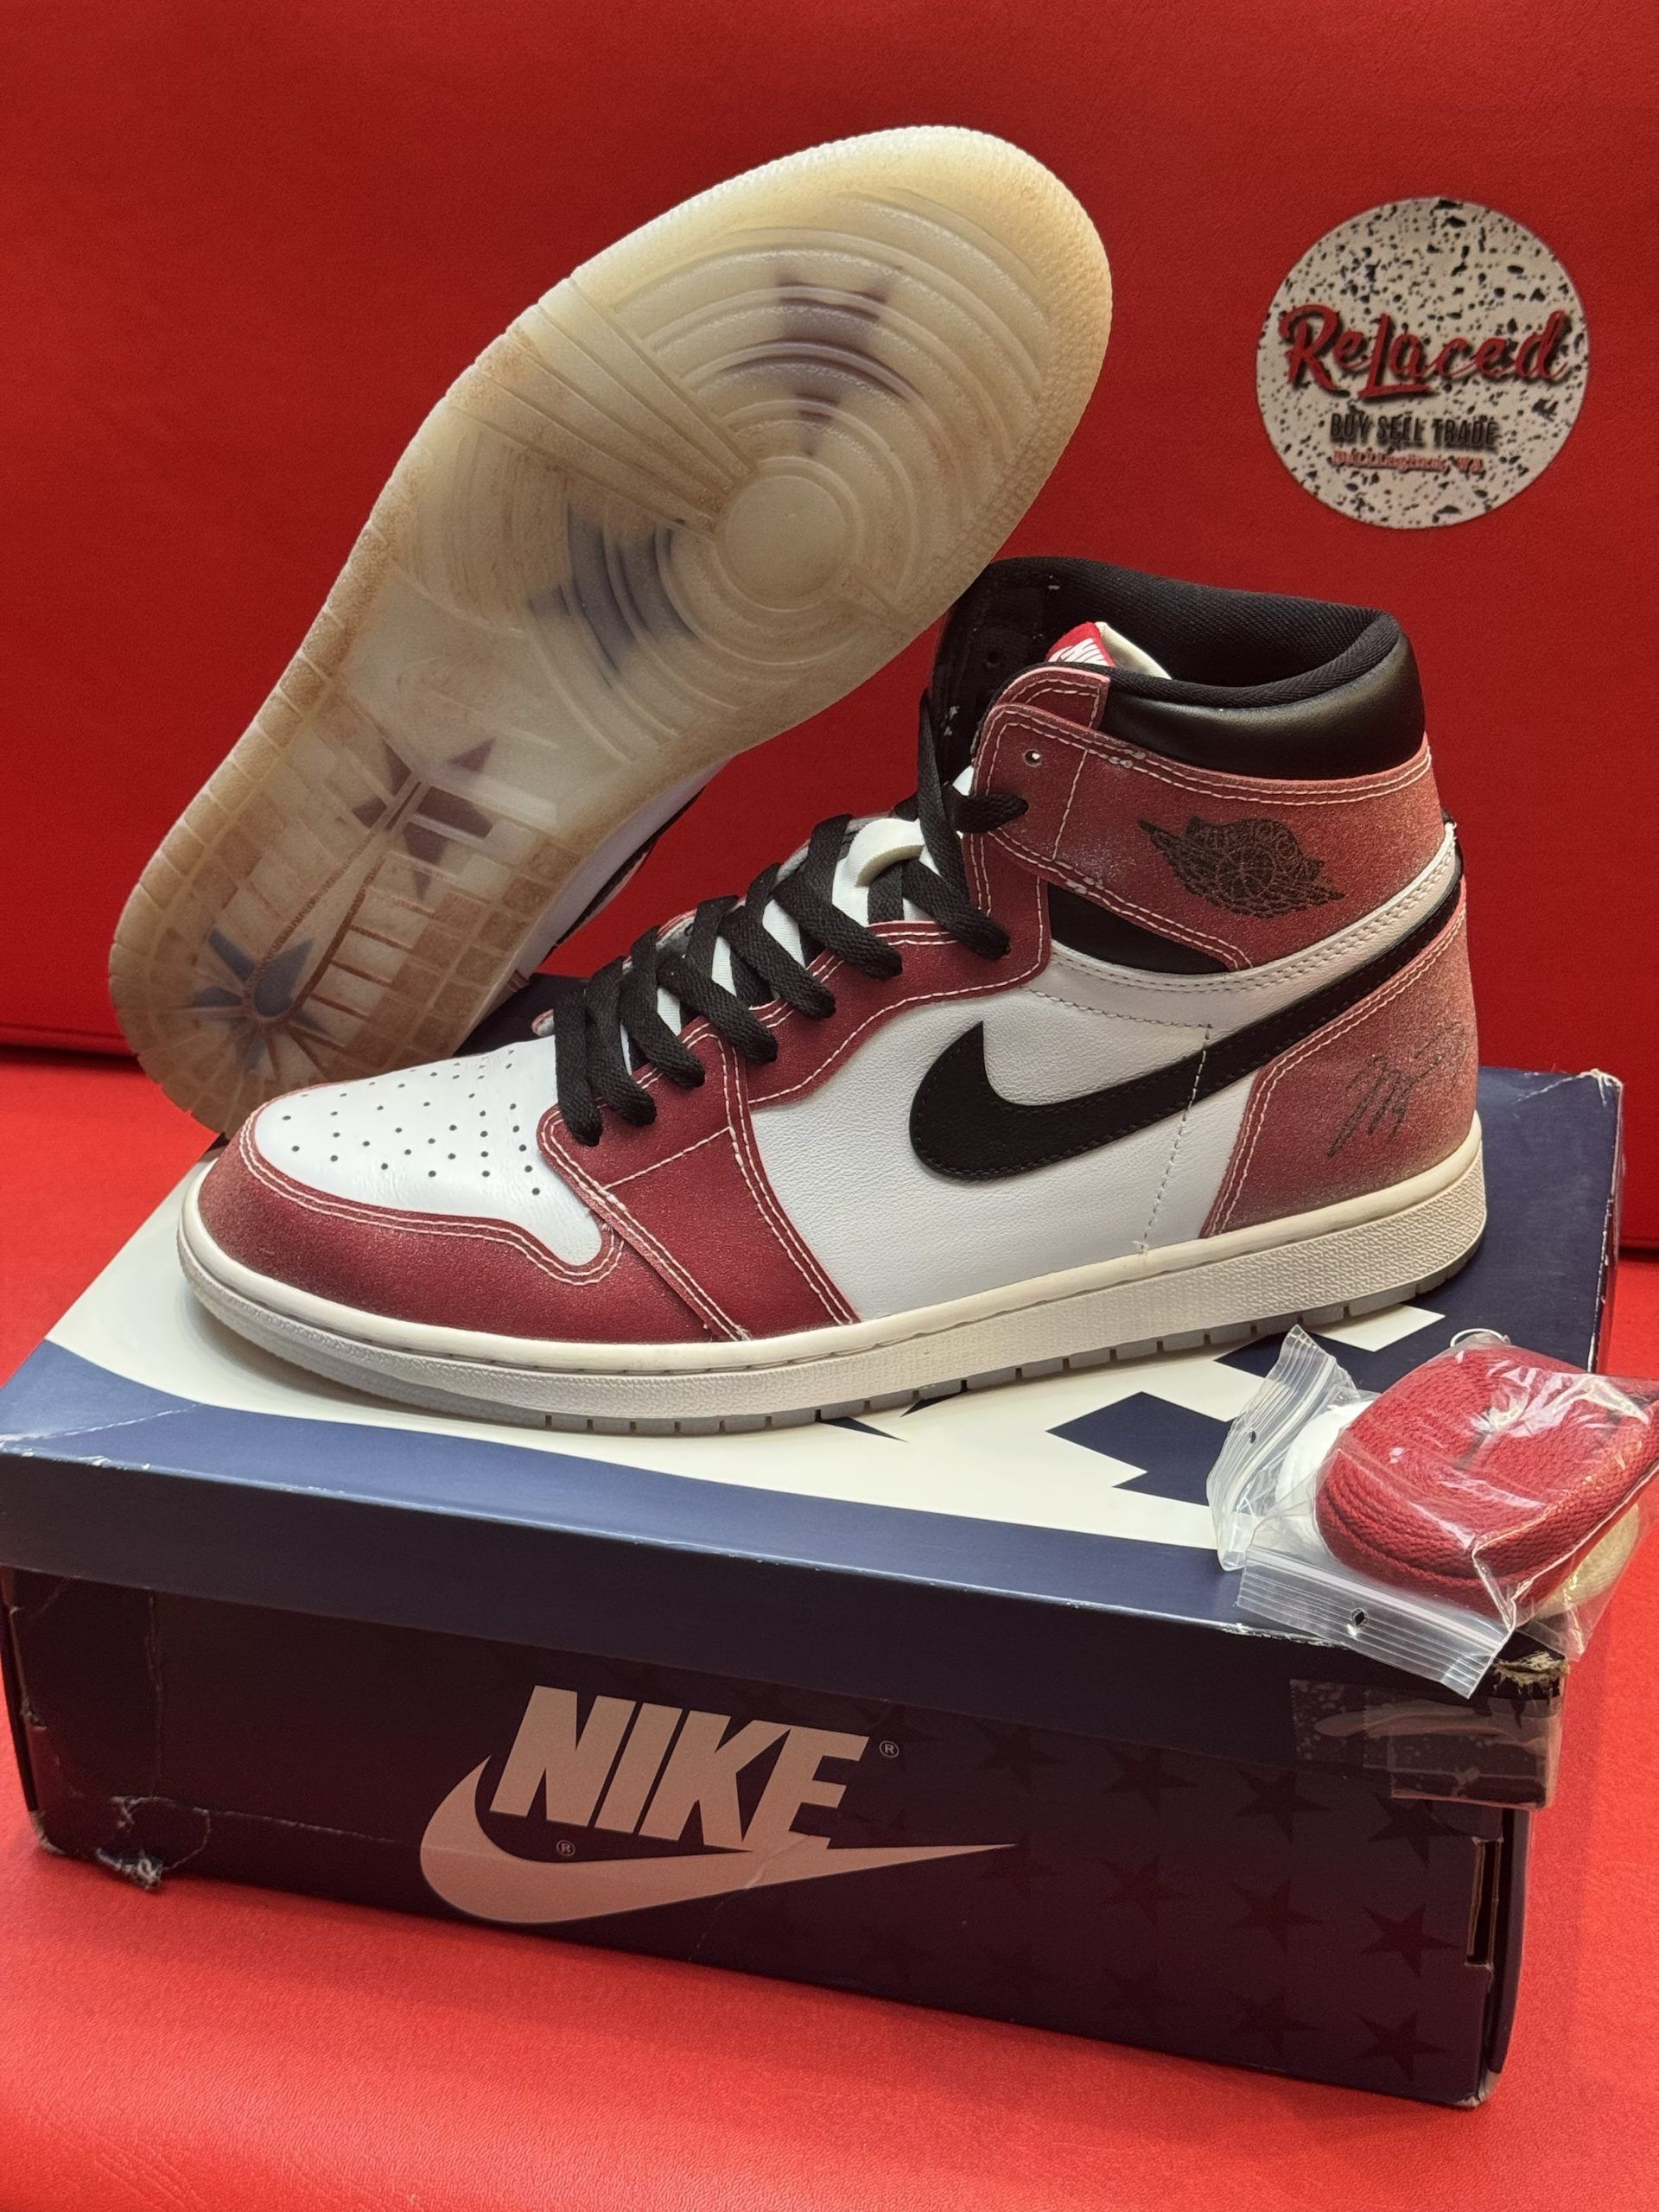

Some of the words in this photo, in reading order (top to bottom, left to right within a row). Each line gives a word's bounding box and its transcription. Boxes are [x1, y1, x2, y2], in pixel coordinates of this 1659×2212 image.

[1279, 303, 1570, 398] ReLaced
[1331, 413, 1370, 440] BUY
[1377, 416, 1424, 444] SELL
[1432, 418, 1498, 448] TRADE
[490, 1685, 870, 1851] NIKE
